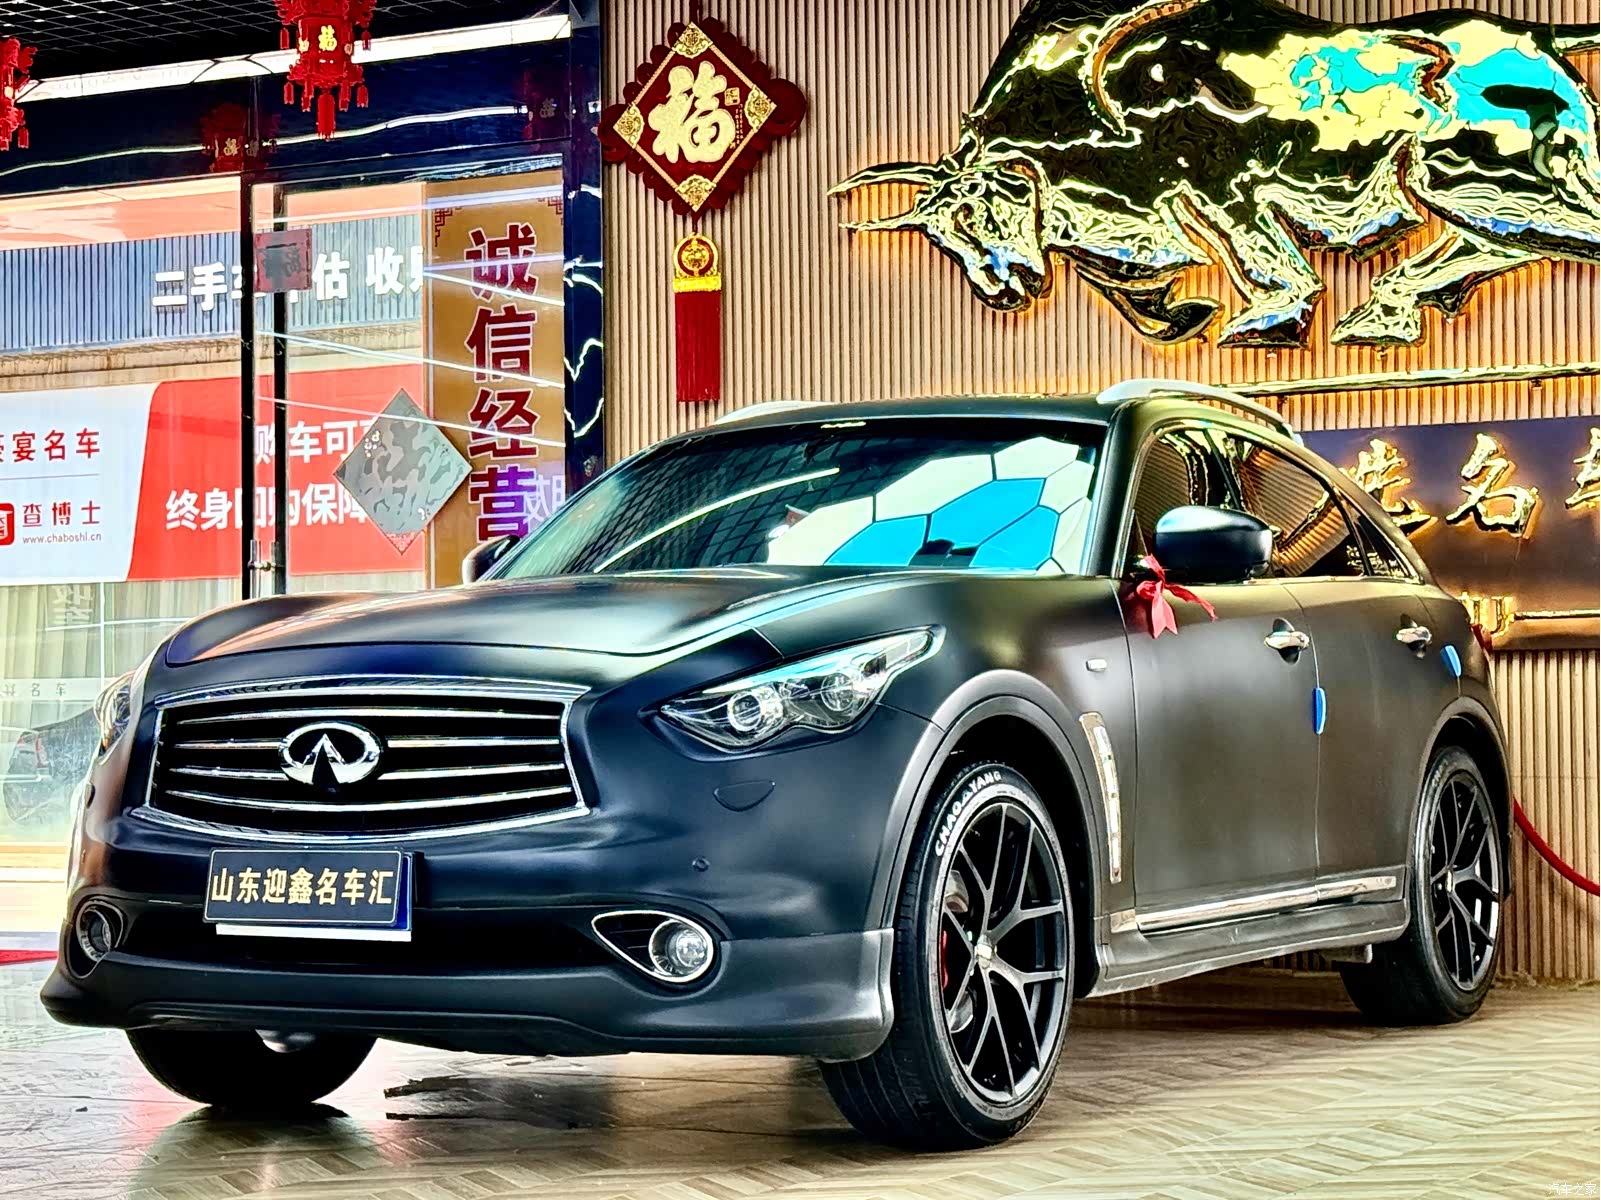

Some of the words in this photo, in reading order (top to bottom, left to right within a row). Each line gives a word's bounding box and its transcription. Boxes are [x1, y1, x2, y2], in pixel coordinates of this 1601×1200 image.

[648, 60, 736, 163] 福
[464, 222, 539, 544] 诚信经营
[0, 428, 100, 463] 宴名车
[211, 867, 394, 906] 山东迎鑫名车汇
